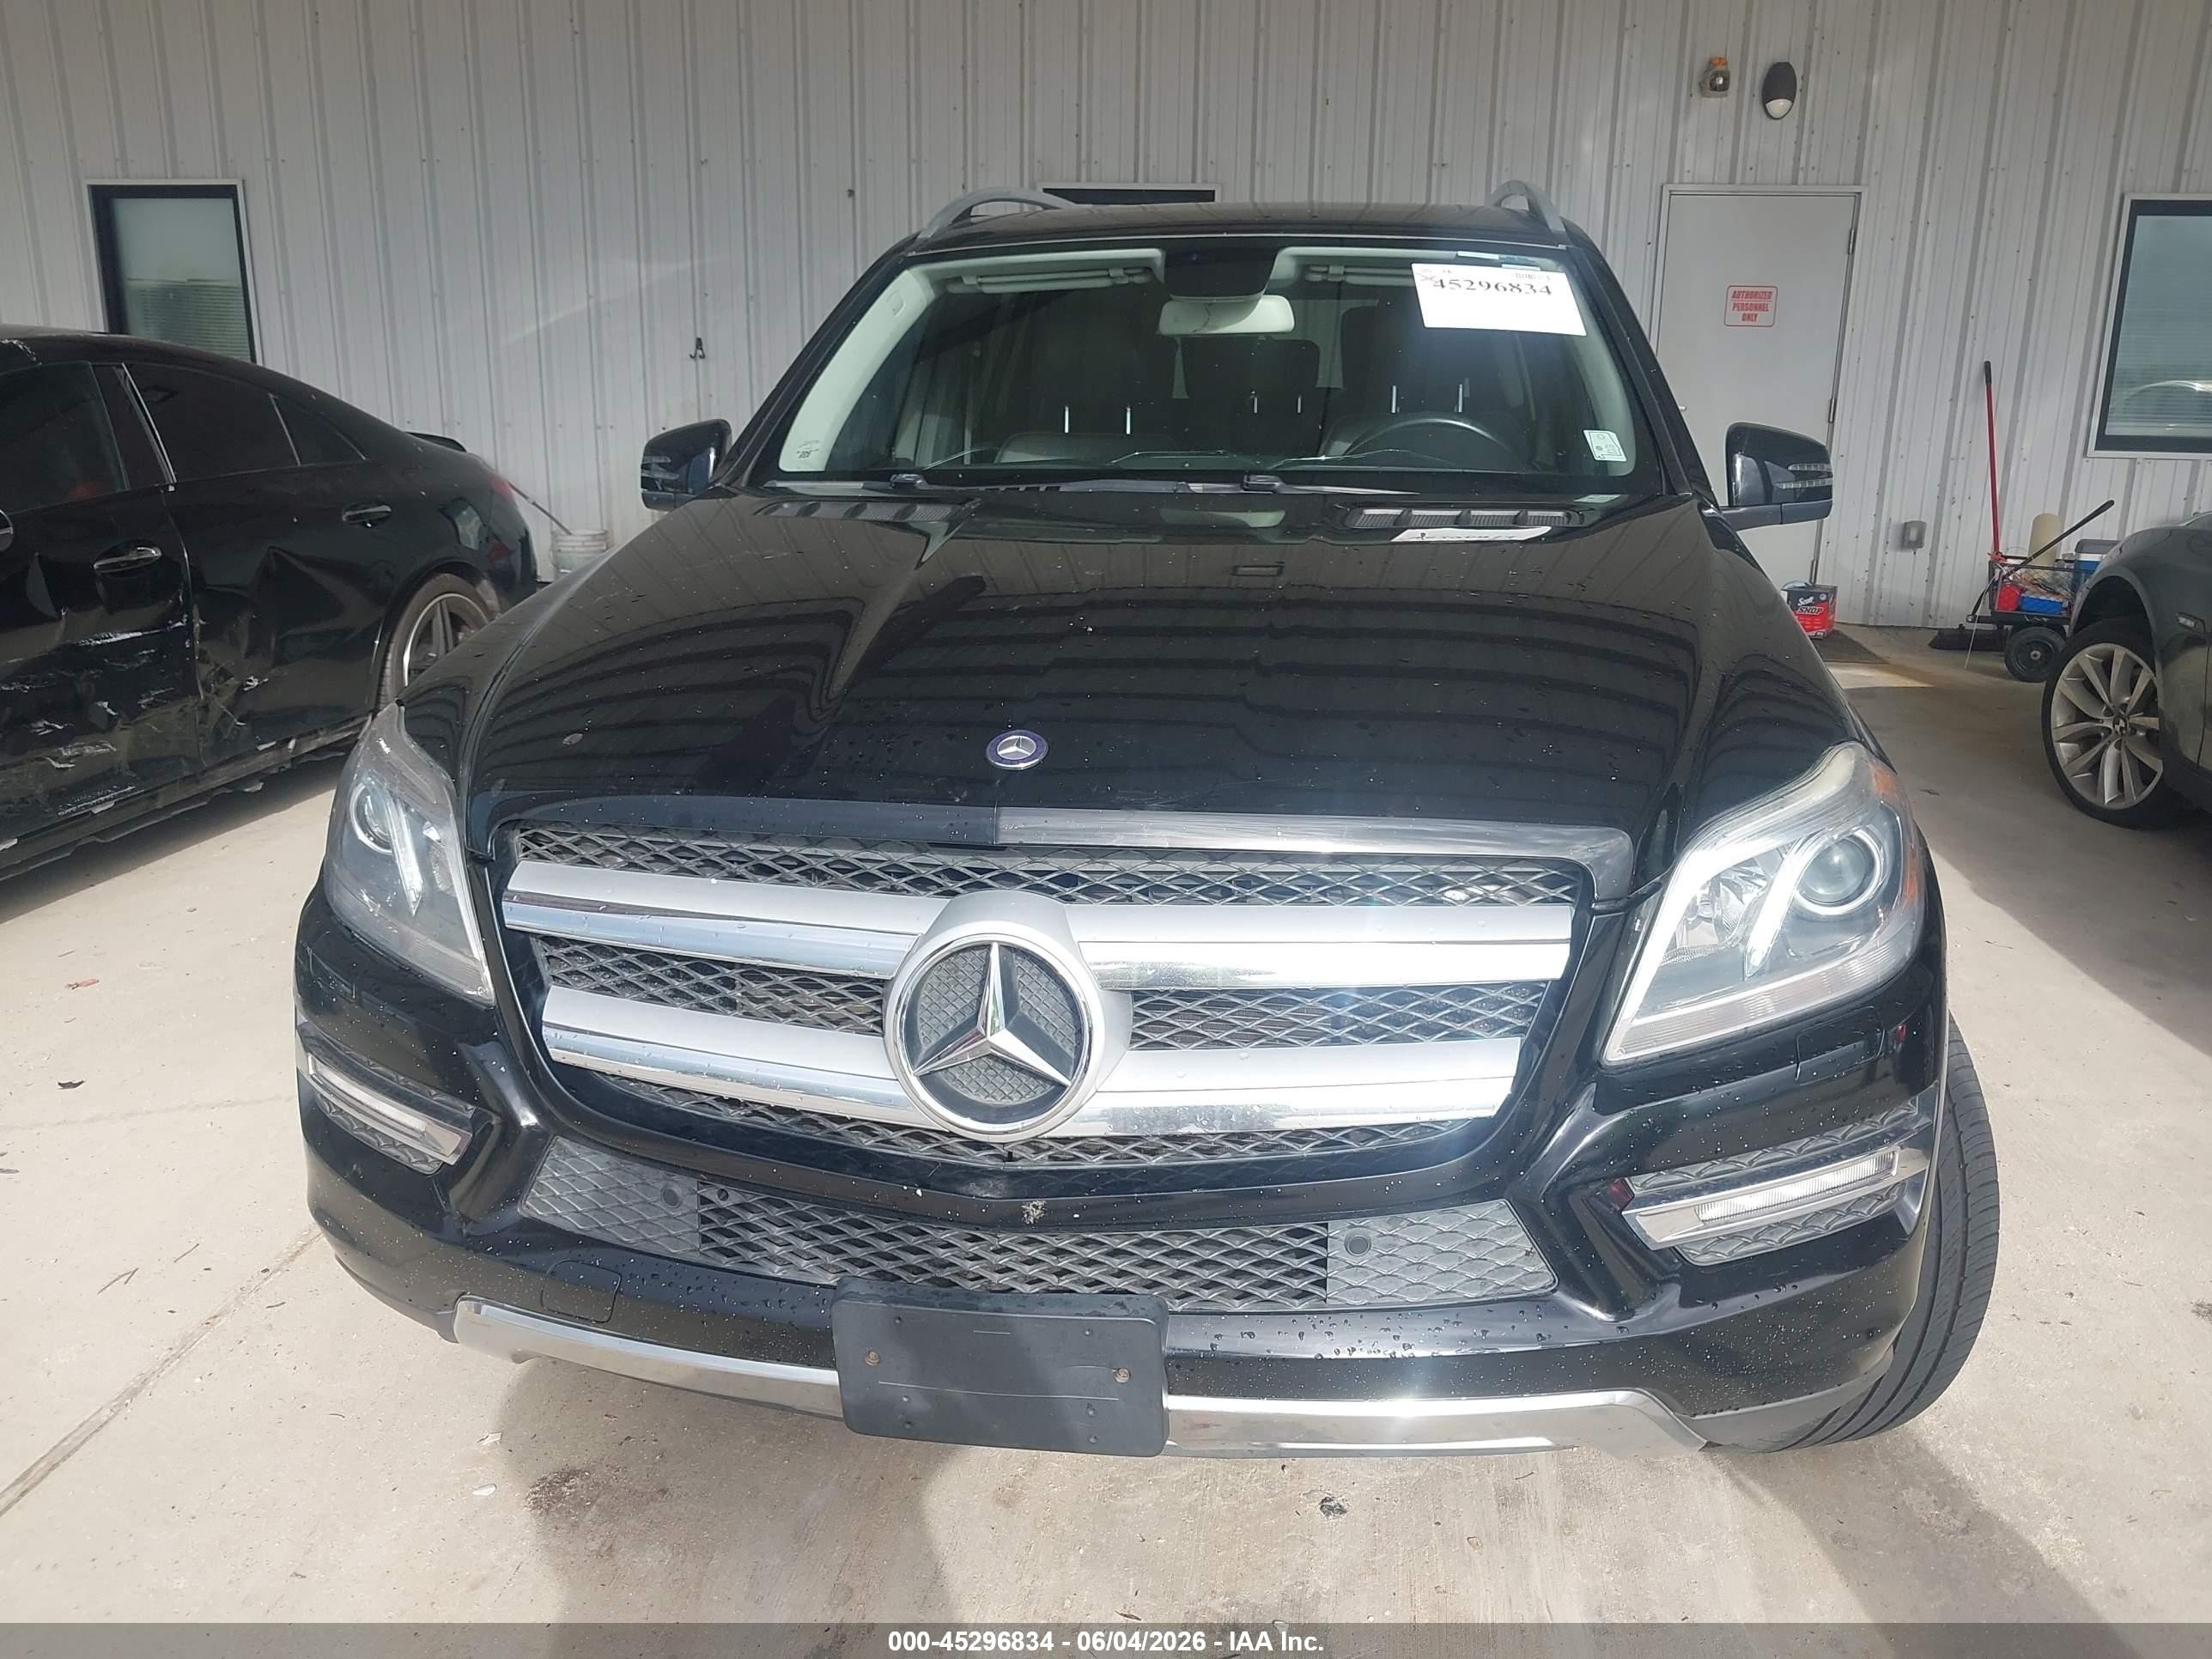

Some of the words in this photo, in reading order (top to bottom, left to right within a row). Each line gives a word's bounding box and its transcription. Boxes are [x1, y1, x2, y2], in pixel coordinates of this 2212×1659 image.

[1433, 277, 1553, 296] 45296834
[1731, 290, 1773, 300] AUTHORIZED
[1732, 302, 1769, 312] PERSONNEL
[1741, 313, 1759, 322] ONLY
[1798, 606, 1823, 615] SHOP
